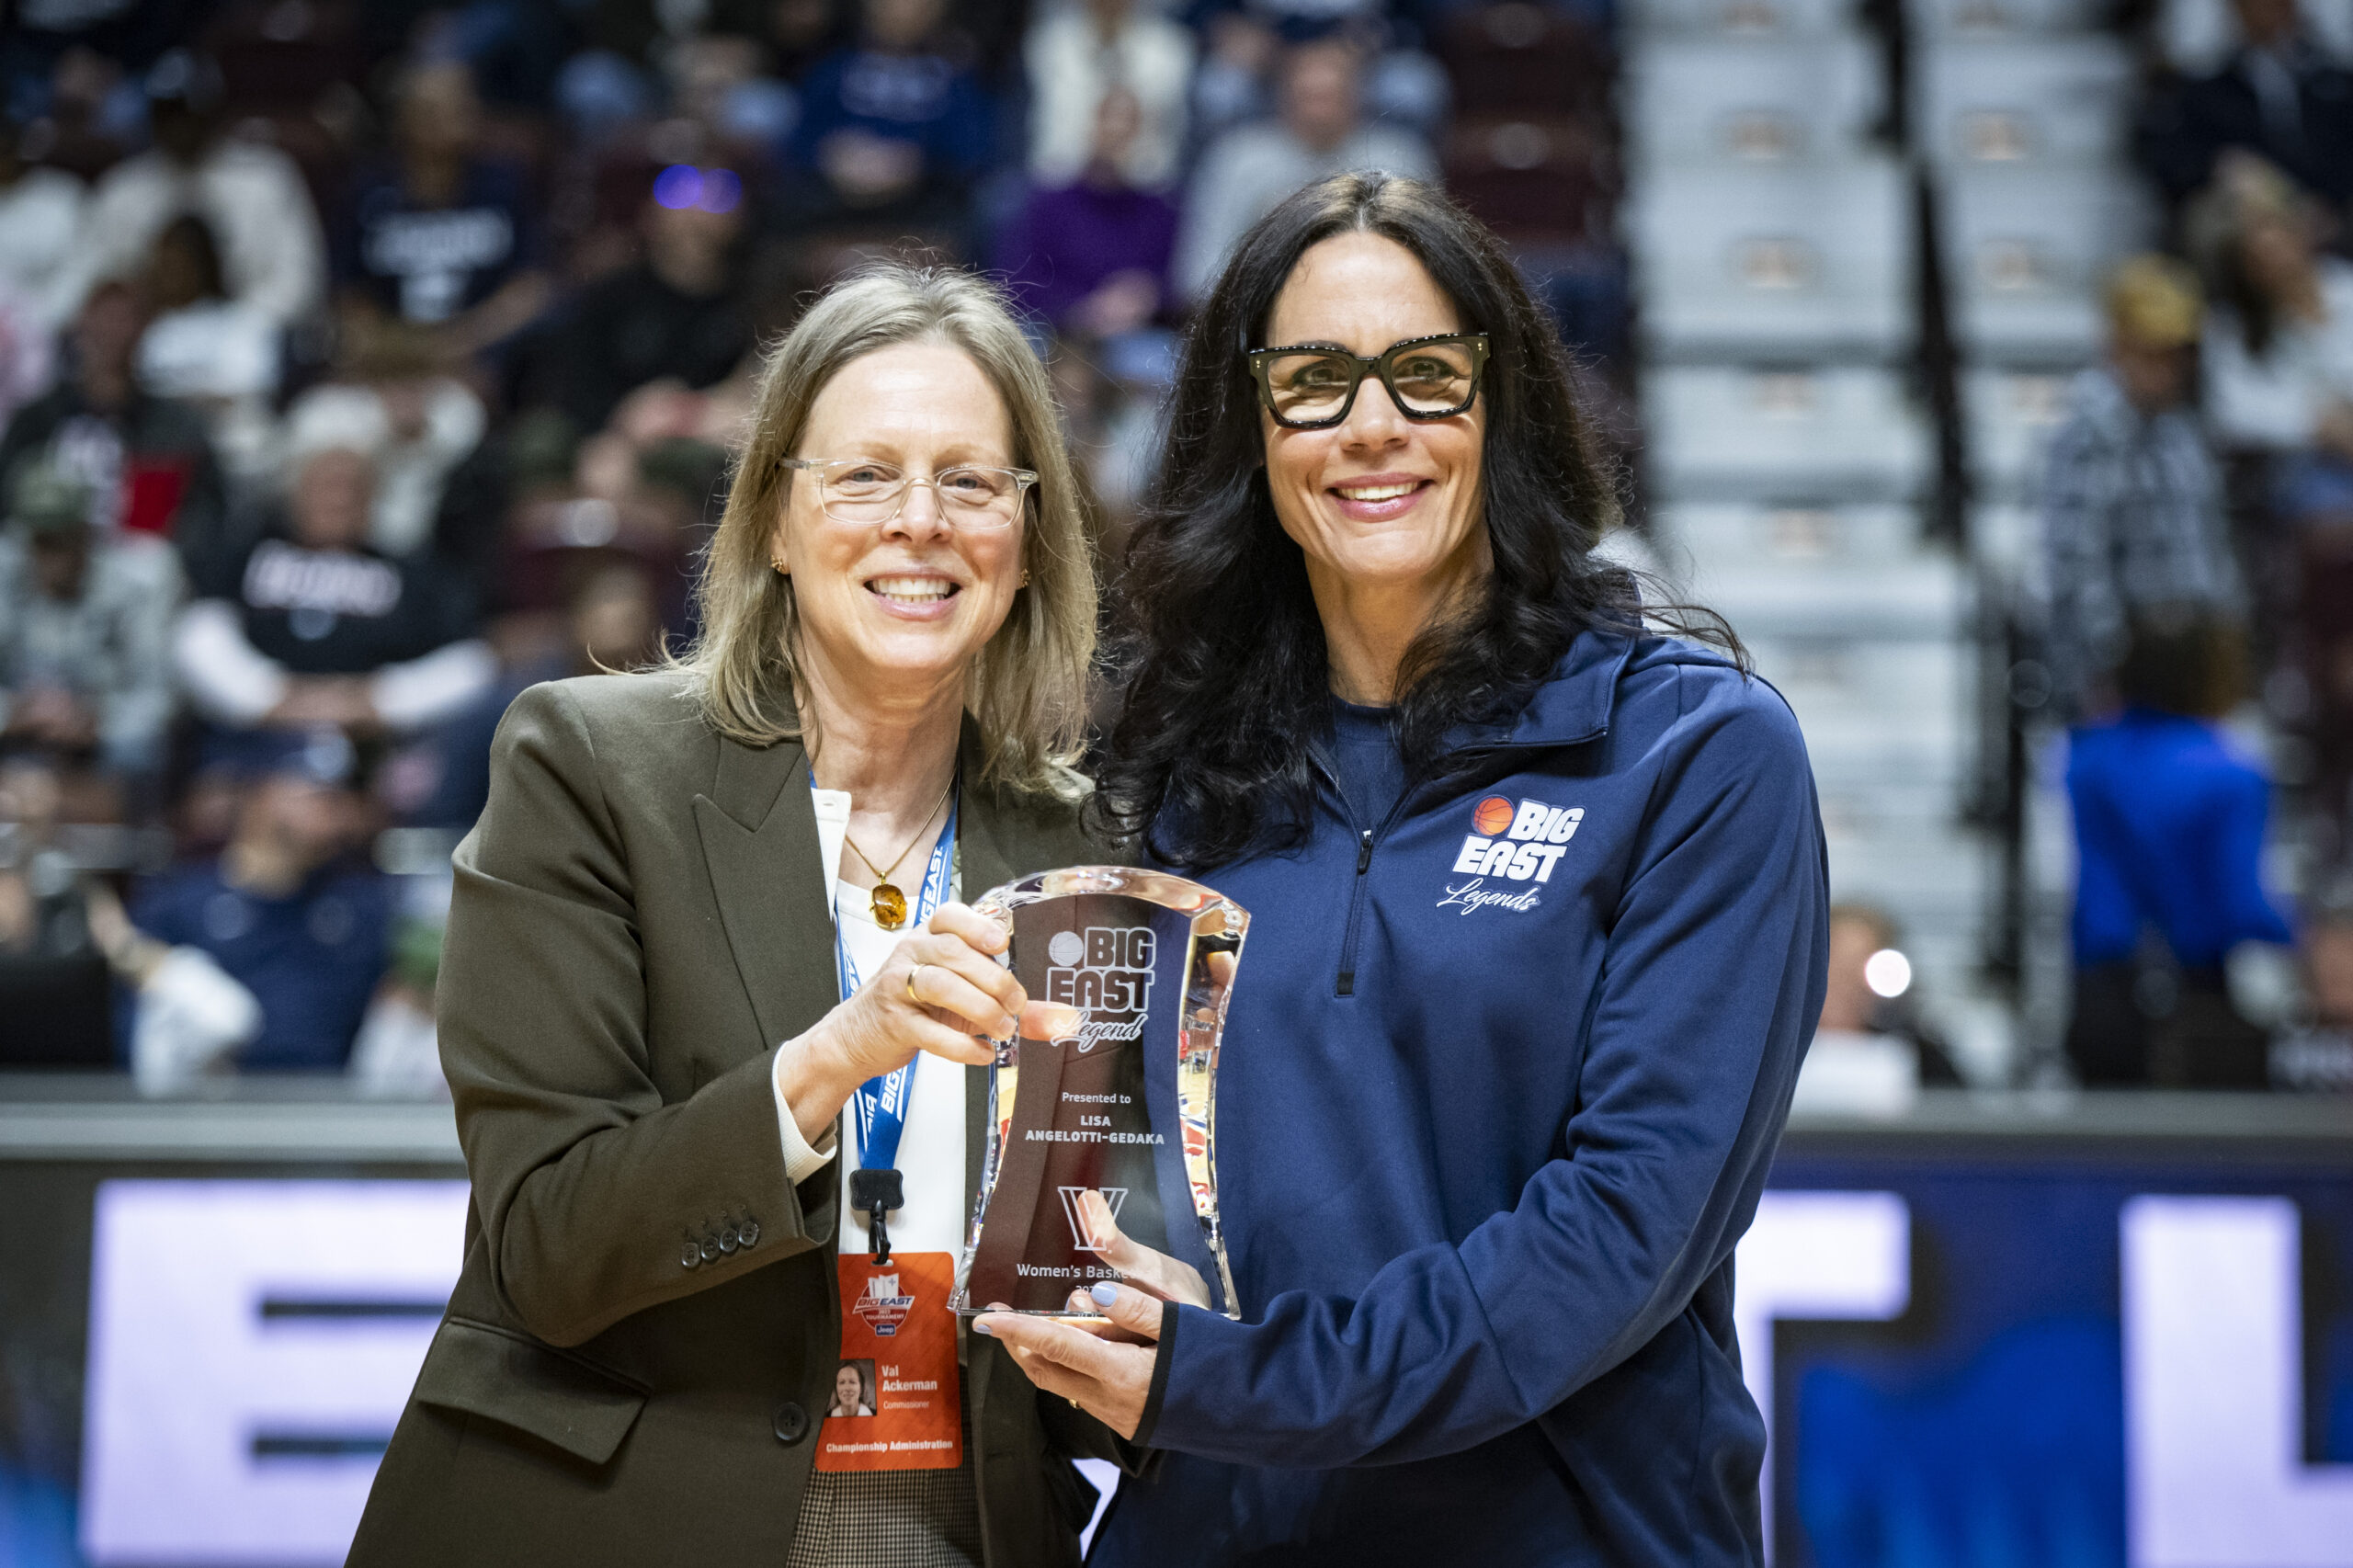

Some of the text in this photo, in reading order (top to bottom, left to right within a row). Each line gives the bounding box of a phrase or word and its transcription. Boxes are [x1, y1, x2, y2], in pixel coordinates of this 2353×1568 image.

[1507, 800, 1586, 844] BIG
[1452, 835, 1568, 882] EAST
[1437, 877, 1540, 915] Legends
[1084, 926, 1156, 971] BIG
[1046, 967, 1155, 1013] EAST
[1062, 1092, 1131, 1104] Presented to
[1080, 1115, 1111, 1127] LISA
[1025, 1130, 1165, 1145] ANGELOTTI-GEDAKA
[1017, 1263, 1082, 1278] Women's
[877, 1325, 893, 1335] Jeep
[881, 1365, 899, 1378] Val
[882, 1380, 938, 1392] Ackerman
[883, 1400, 930, 1410] Commissioner
[826, 1439, 953, 1453] Championship Administration
